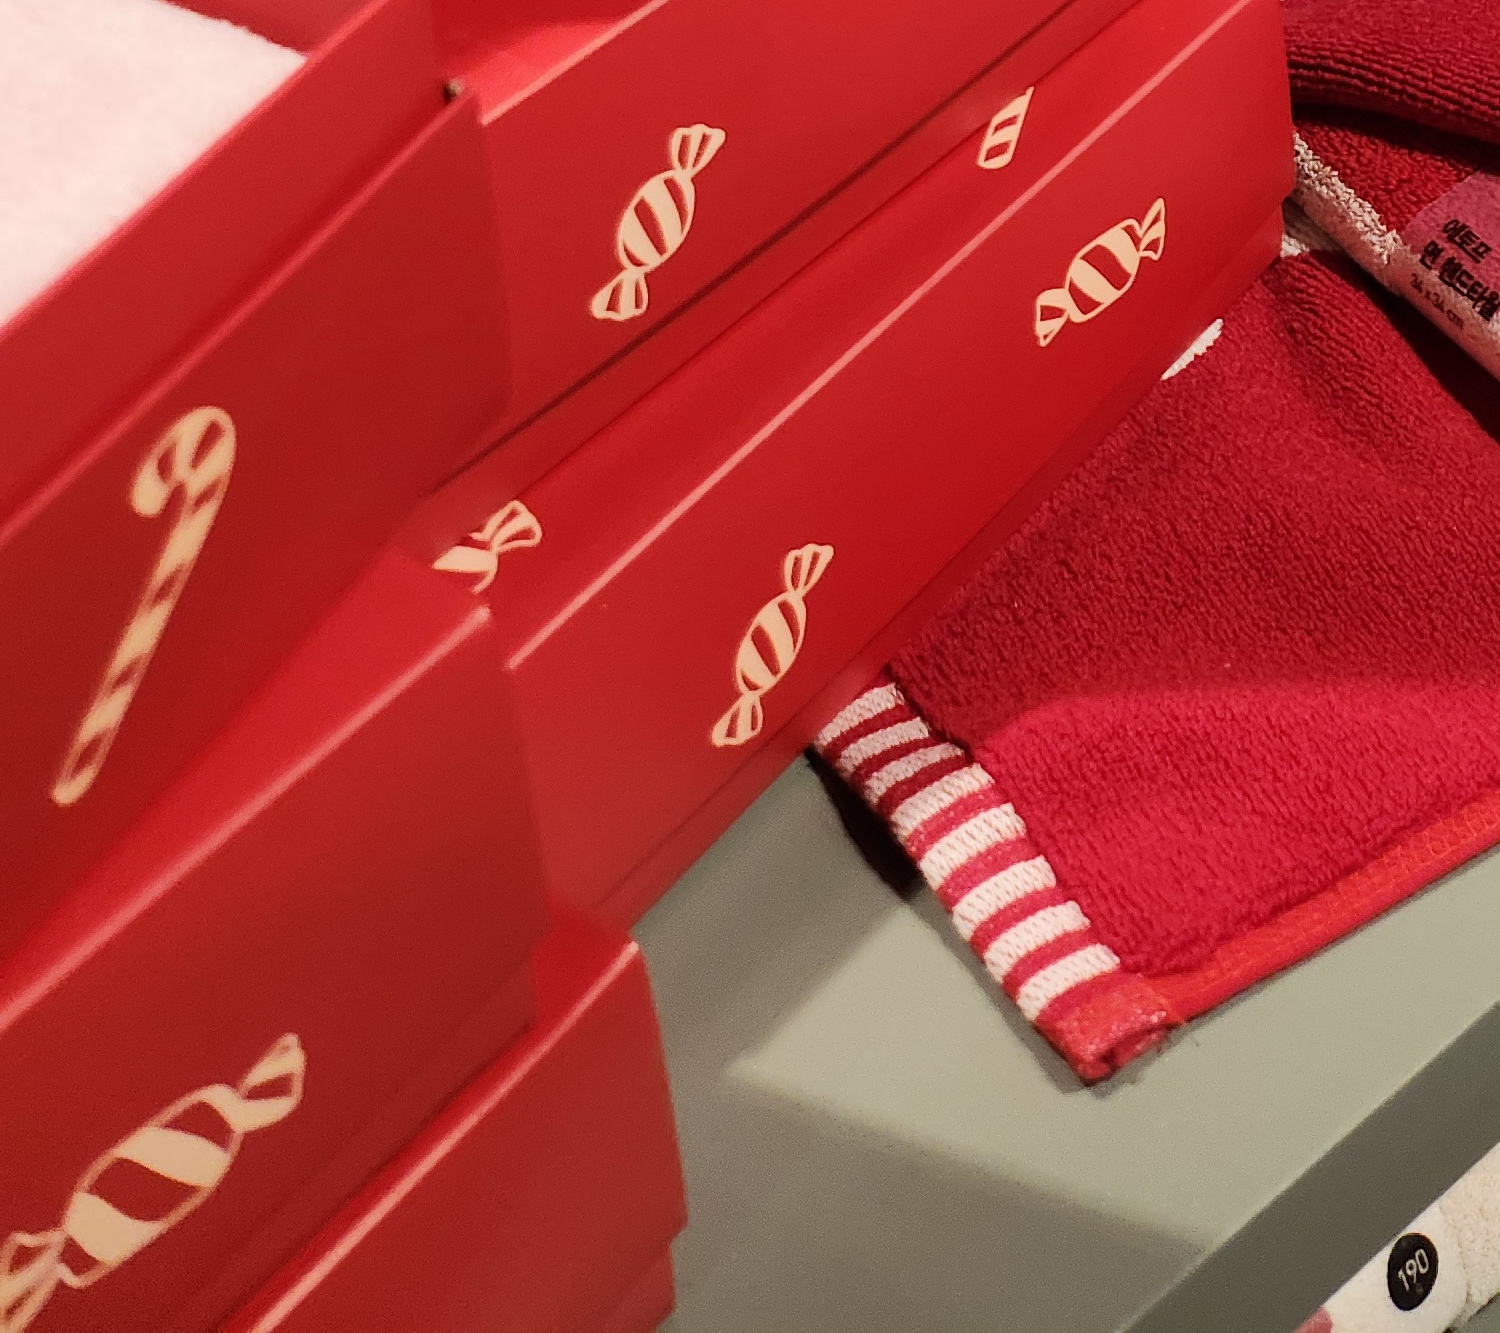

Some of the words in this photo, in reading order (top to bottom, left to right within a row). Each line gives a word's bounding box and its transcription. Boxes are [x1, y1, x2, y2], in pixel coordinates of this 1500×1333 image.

[1420, 240, 1444, 270] 면
[1442, 219, 1492, 263] 에토프
[1398, 1248, 1429, 1292] 190
